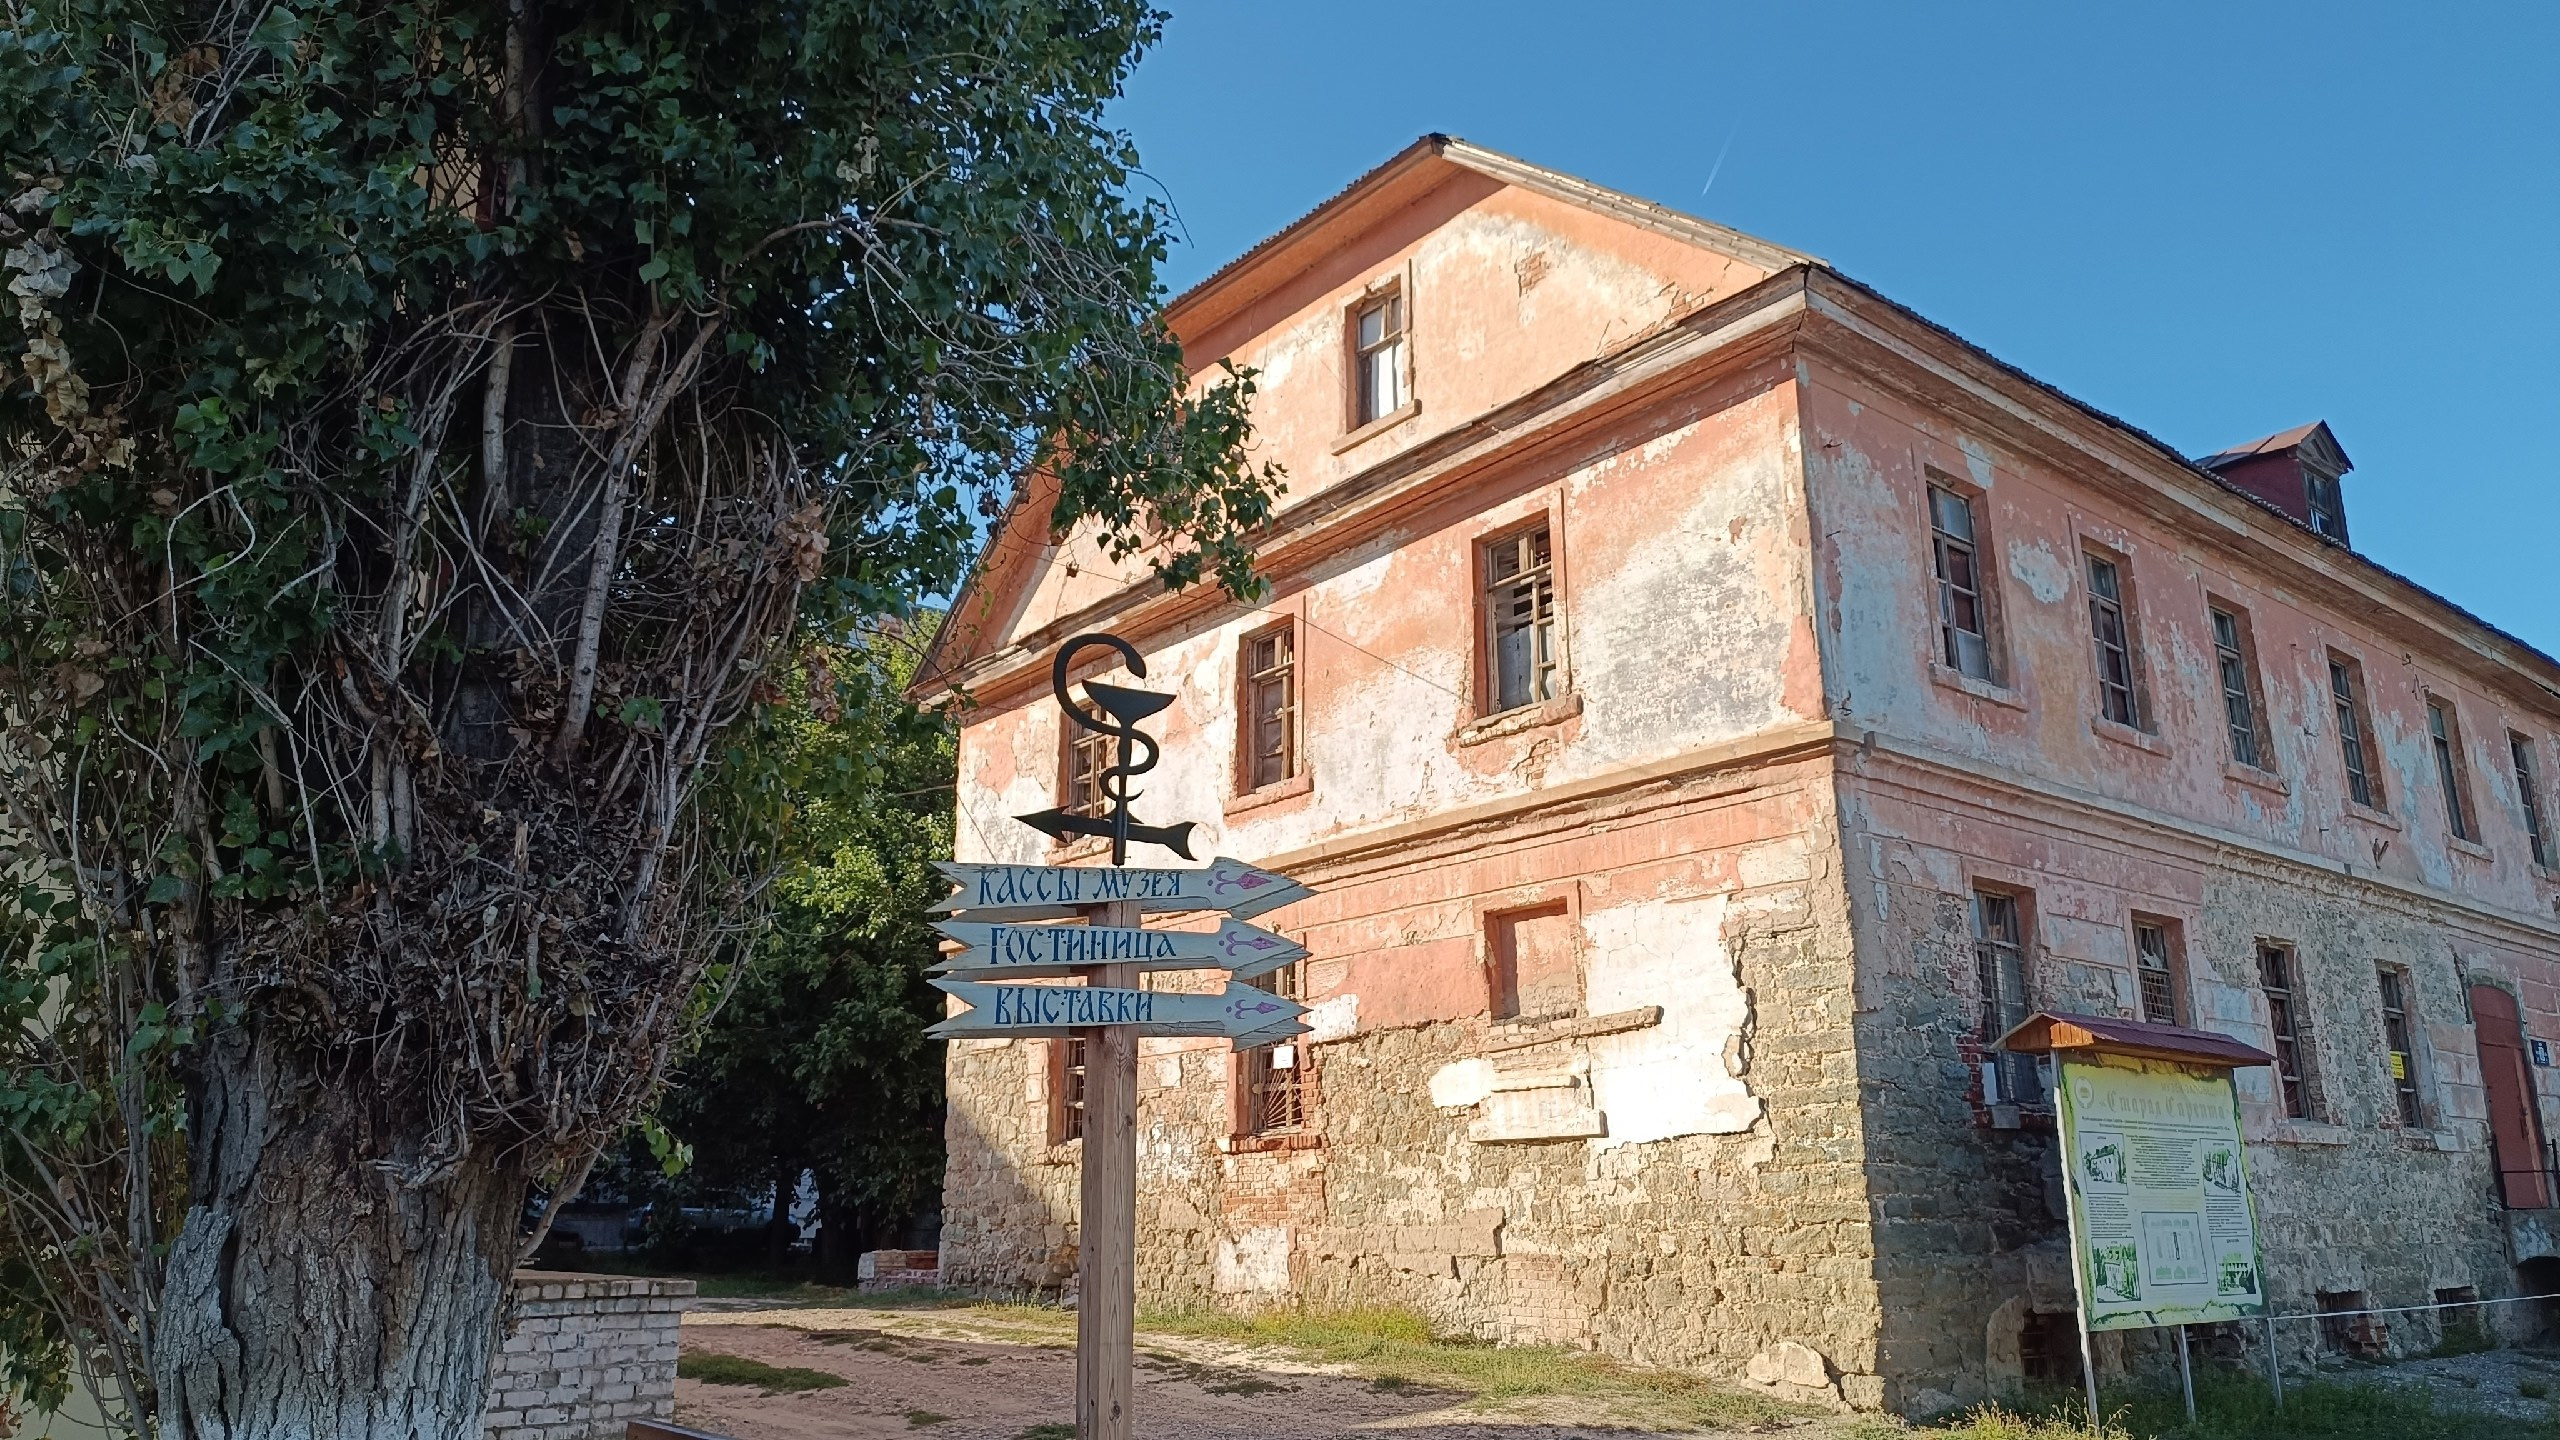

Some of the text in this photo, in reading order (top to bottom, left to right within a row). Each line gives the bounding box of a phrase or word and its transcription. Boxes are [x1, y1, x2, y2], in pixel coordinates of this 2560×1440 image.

[978, 867, 1183, 905] КАССЫ МУЗЕЯ
[994, 986, 1154, 1025] ВЫСТАВКИ
